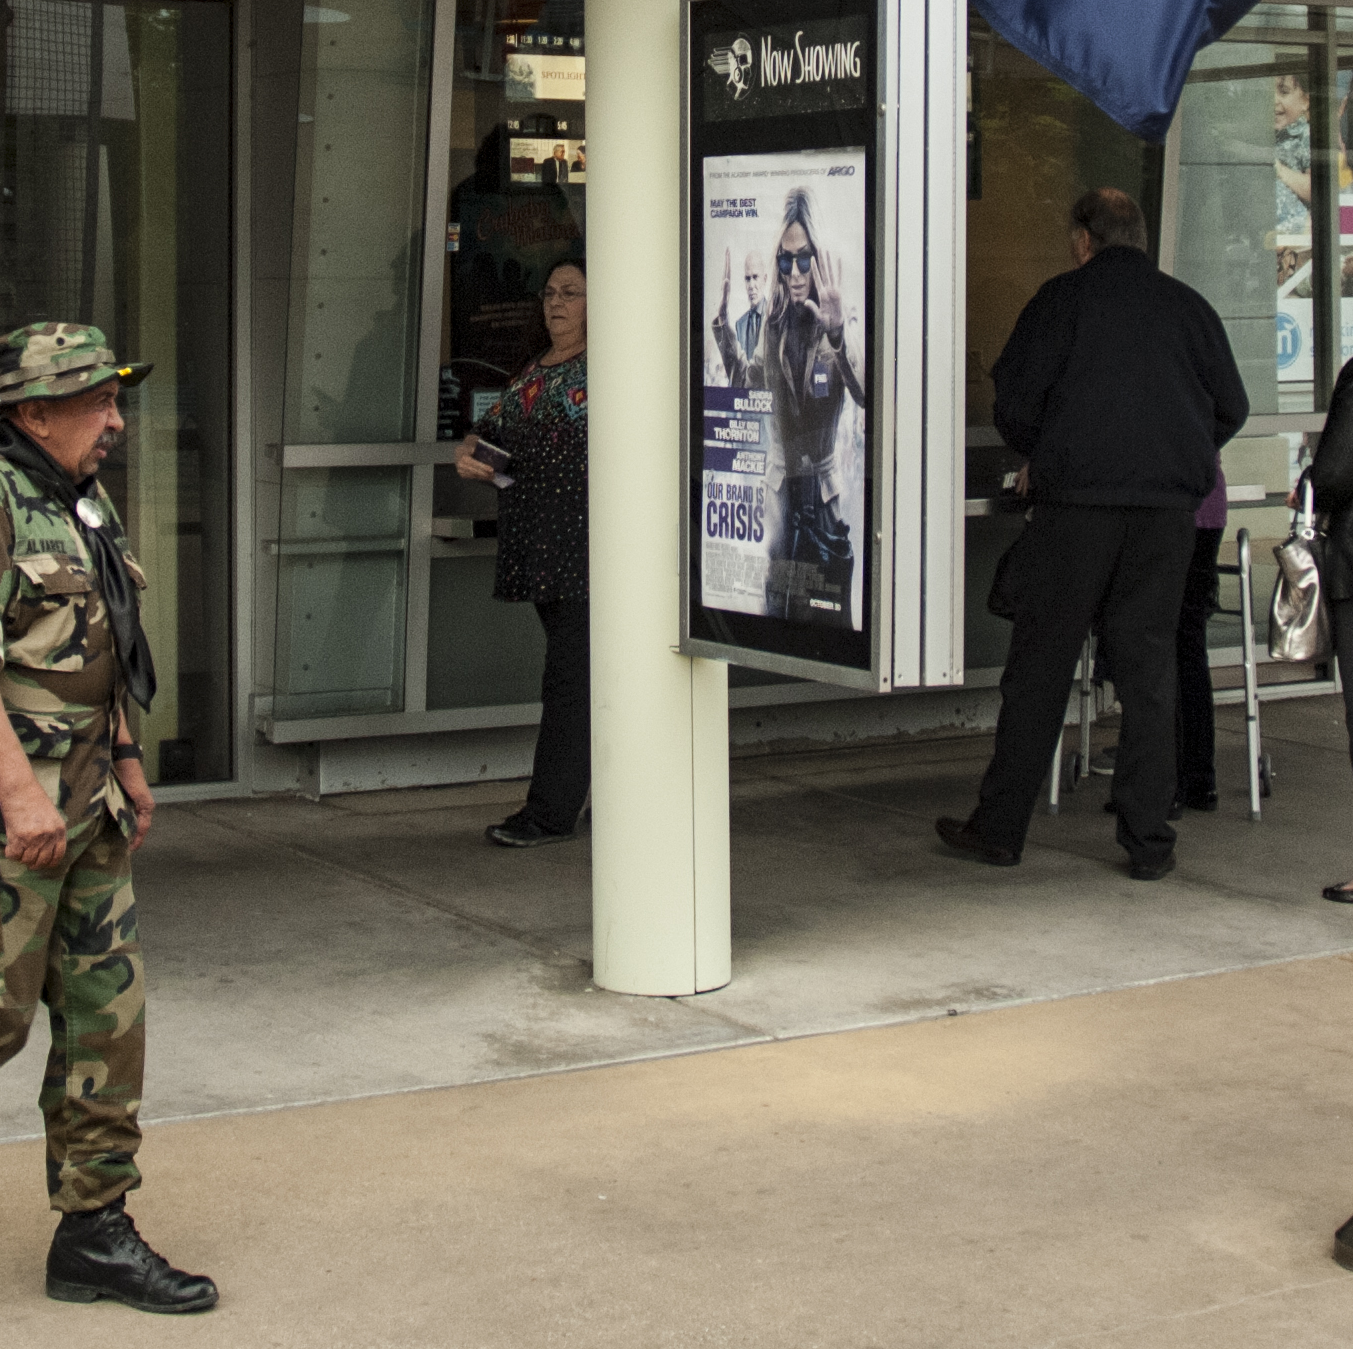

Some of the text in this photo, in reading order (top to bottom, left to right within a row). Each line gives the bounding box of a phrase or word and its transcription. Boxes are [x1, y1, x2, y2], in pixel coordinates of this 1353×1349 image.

[828, 166, 855, 177] ARGO
[710, 198, 756, 208] MAY THE BEST
[710, 209, 744, 218] CAMPAIGN
[734, 398, 773, 412] BULLOCK
[714, 428, 759, 442] THORNTON
[732, 459, 765, 472] MACKIE
[707, 482, 764, 505] OUR BRAND IS
[706, 500, 765, 543] CRISIS
